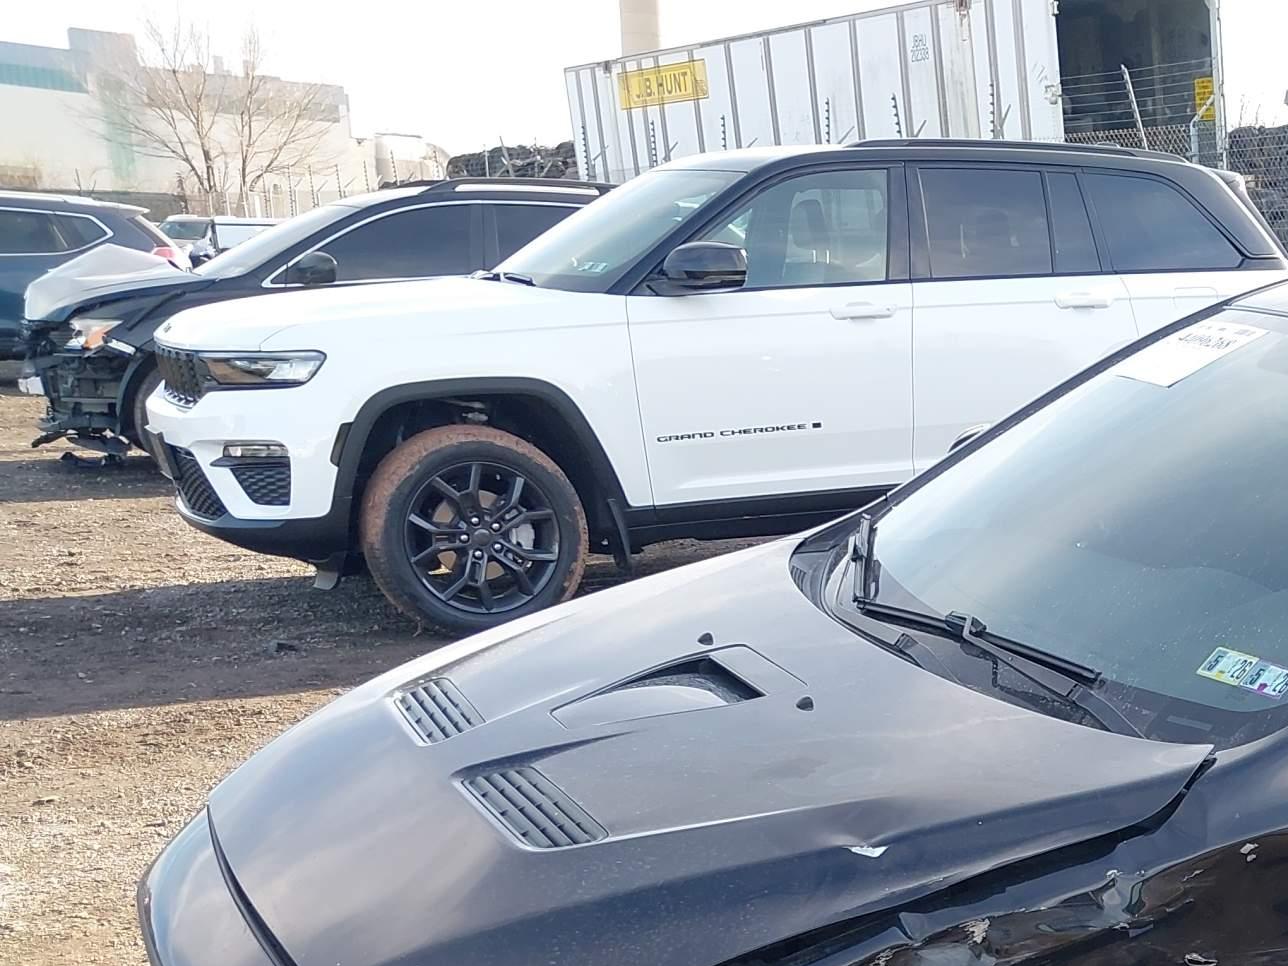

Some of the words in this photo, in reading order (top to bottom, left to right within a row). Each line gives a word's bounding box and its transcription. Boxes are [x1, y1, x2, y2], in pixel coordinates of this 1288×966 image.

[656, 71, 688, 95] HUNT
[656, 431, 715, 443] GRAND
[719, 423, 807, 437] CHEROKEE
